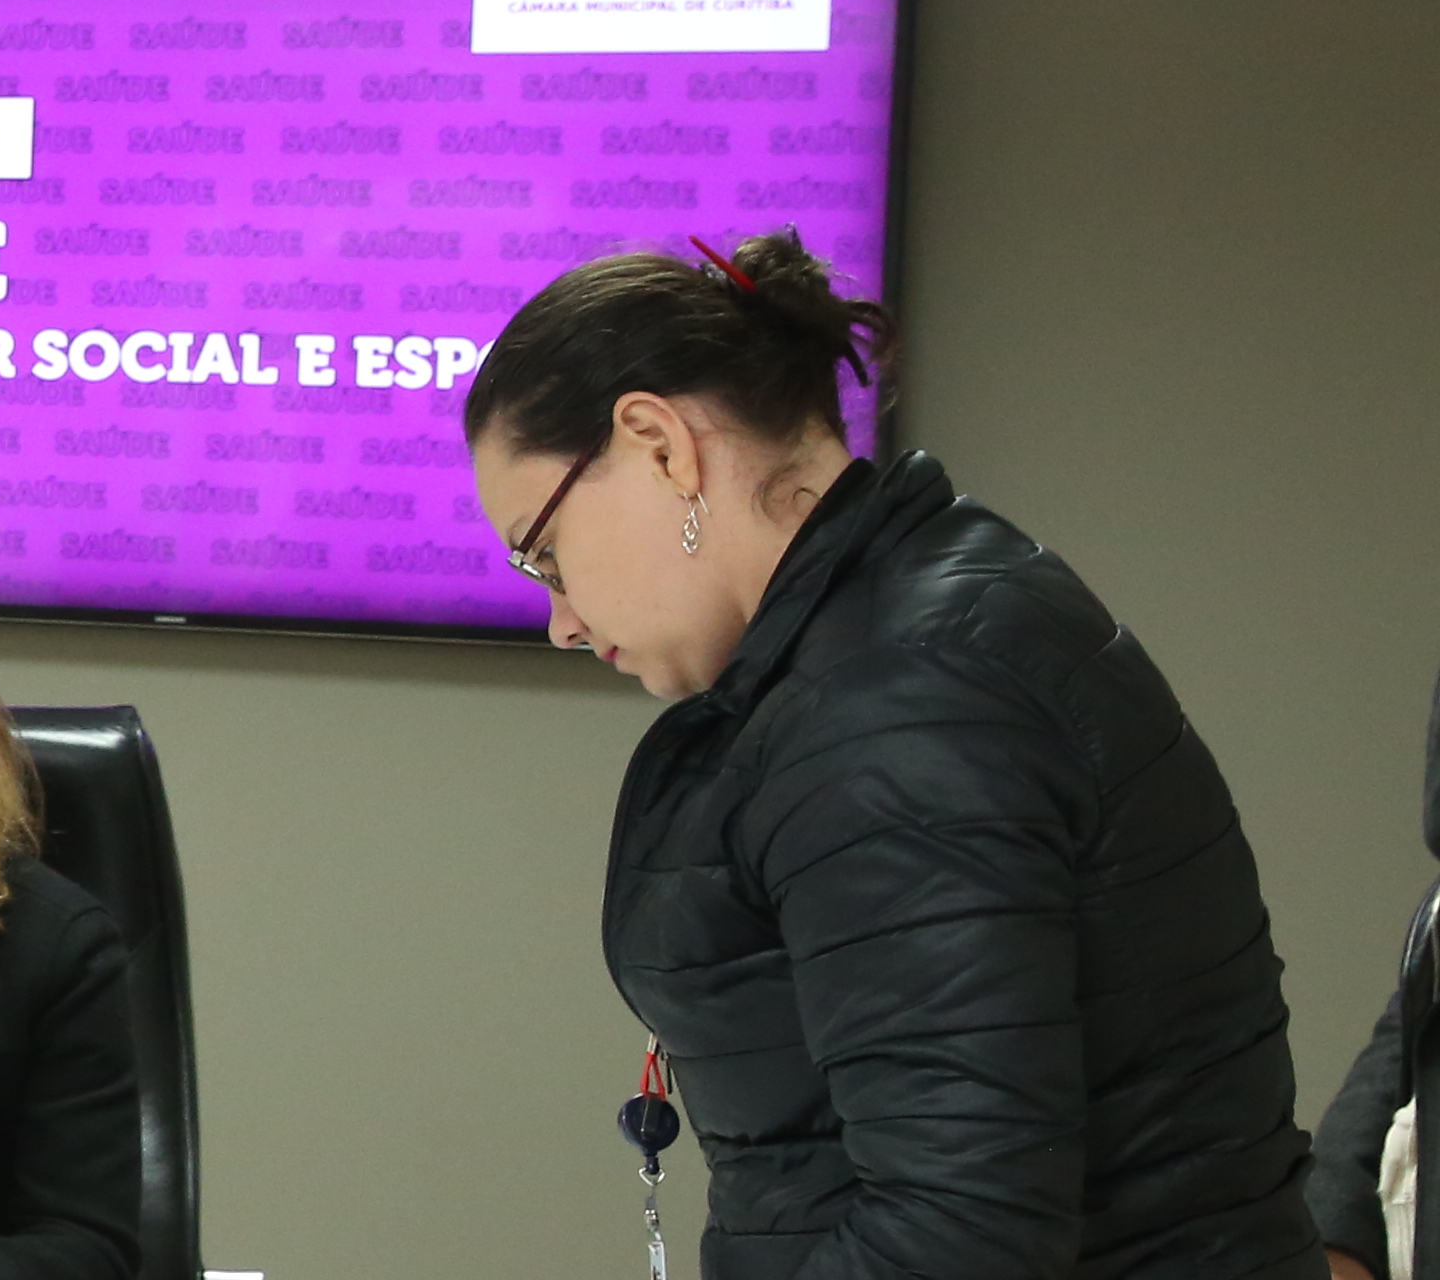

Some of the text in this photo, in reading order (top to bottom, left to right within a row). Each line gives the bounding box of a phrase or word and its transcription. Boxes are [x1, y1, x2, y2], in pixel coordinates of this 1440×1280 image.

[585, 0, 677, 13] MUNICIPAL
[685, 0, 706, 12] DE
[32, 329, 279, 386] SOCIAL
[294, 333, 338, 388] E
